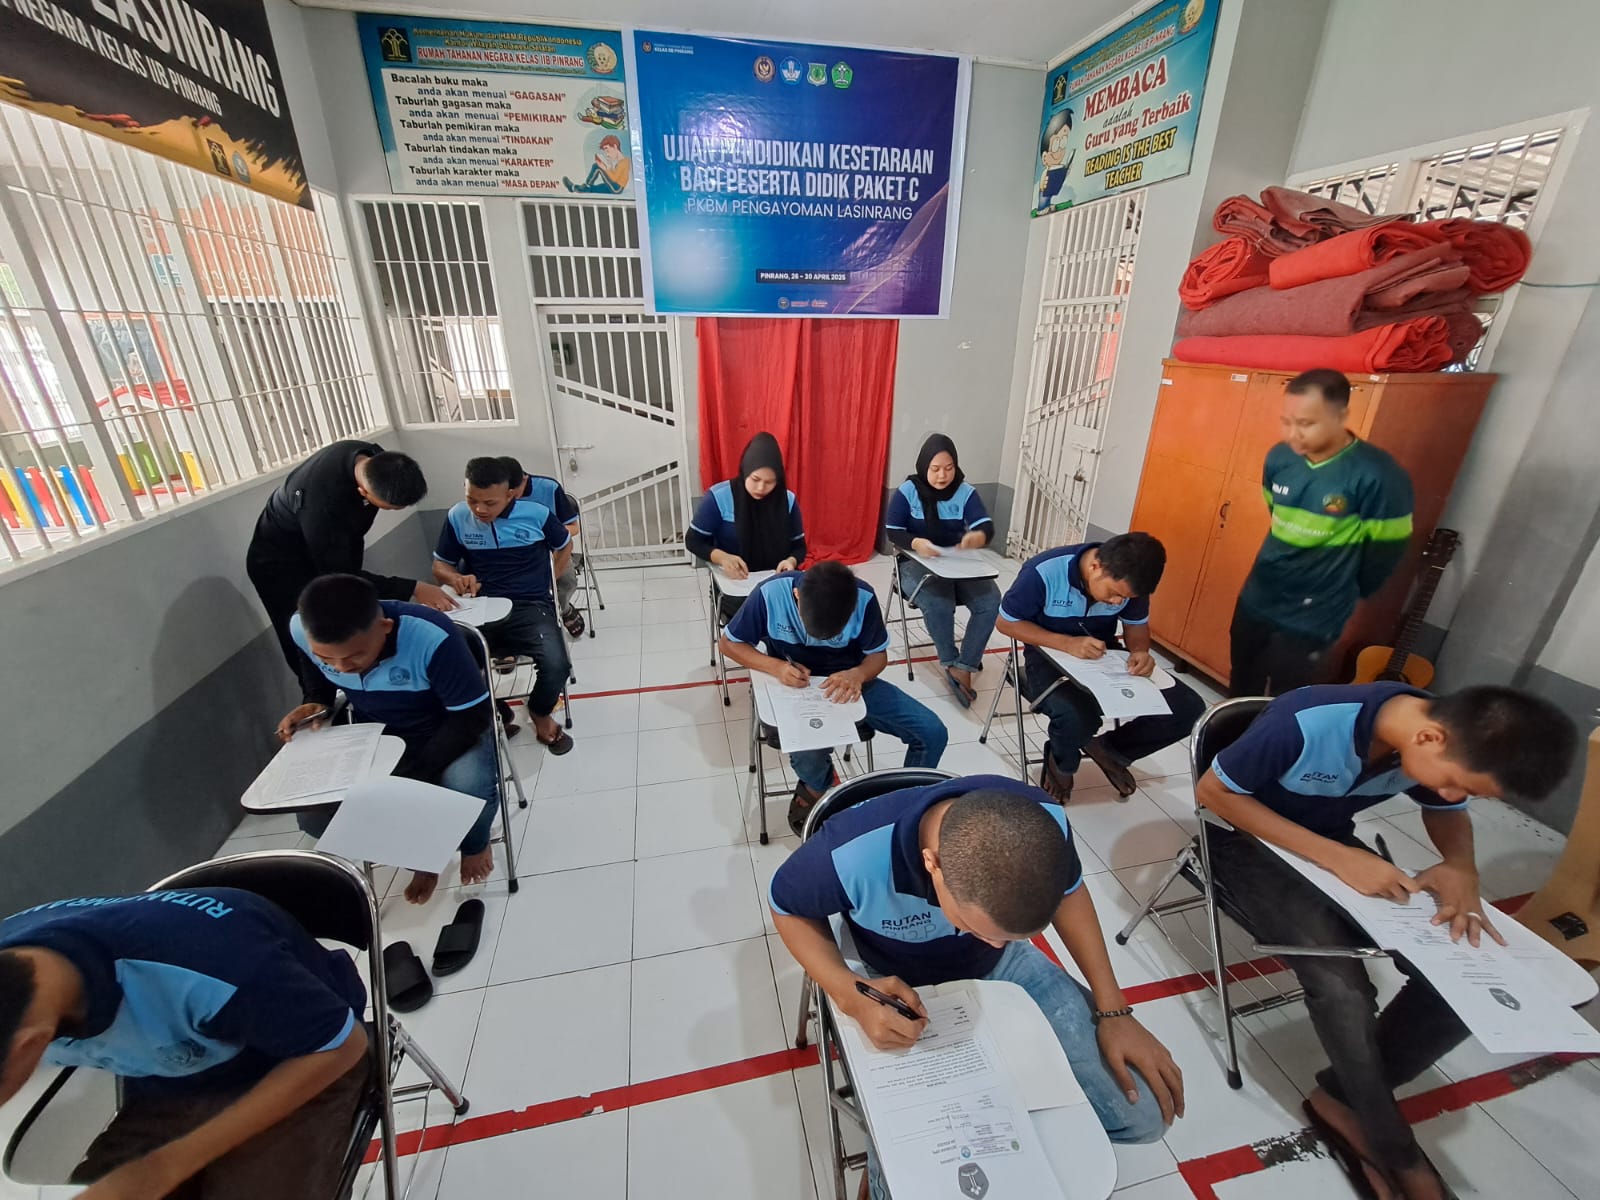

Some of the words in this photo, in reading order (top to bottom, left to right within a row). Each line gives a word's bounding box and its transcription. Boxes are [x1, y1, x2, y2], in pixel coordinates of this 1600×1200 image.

[15, 0, 94, 50] NEGARA
[90, 25, 148, 78] KELAS
[146, 56, 170, 89] IIB
[168, 68, 223, 116] PINRANG
[92, 0, 281, 118] ASINRANG
[417, 47, 445, 58] RUMAH
[447, 49, 482, 61] TAHANAN
[484, 51, 513, 62] NEGARA
[516, 53, 538, 64] KELAS
[541, 54, 550, 65] IIB
[553, 55, 584, 67] PINRANG
[391, 73, 432, 84] Bacalah
[434, 77, 459, 86] buku
[462, 79, 488, 87] maka
[418, 86, 441, 96] anda
[445, 88, 469, 97] akan
[472, 90, 507, 99] menuai
[1083, 57, 1167, 121] MEMBACA
[395, 96, 439, 106] Taburlah
[442, 99, 483, 110] gagasan
[486, 101, 511, 109] maka
[409, 109, 433, 118] anda
[436, 110, 460, 119] akan
[464, 112, 499, 120] menuai
[1085, 127, 1111, 151] Guru
[1111, 118, 1139, 144] yang
[1141, 92, 1191, 129] Terbaik
[1102, 101, 1135, 128] adalah
[400, 119, 442, 129] Taburlah
[445, 121, 492, 132] pemikiran
[495, 124, 520, 133] maka
[423, 132, 444, 141] anda
[446, 133, 466, 142] akan
[469, 134, 499, 143] menuai
[405, 143, 447, 153] Taburlah
[449, 145, 489, 154] tindakan
[492, 147, 517, 155] maka
[663, 134, 718, 162] UJIAN
[721, 138, 825, 169] PENDIDIKAN
[829, 143, 934, 175] KESETARAAN
[1084, 147, 1121, 177] READING
[1120, 143, 1132, 164] IS
[1132, 136, 1152, 160] THE
[1151, 126, 1178, 154] BEST
[423, 156, 444, 164] anda
[446, 157, 466, 165] akan
[469, 158, 499, 166] menuai
[409, 166, 450, 175] Taburlah
[453, 168, 492, 176] karakter
[495, 169, 519, 177] maka
[1105, 161, 1143, 190] TEACHER
[416, 178, 438, 186] anda
[441, 179, 464, 187] akan
[466, 180, 499, 188] menuai
[680, 166, 724, 193] BAGI
[726, 169, 801, 197] PESERTA
[805, 173, 850, 199] DIDIK
[854, 175, 906, 202] PAKET
[908, 177, 919, 202] C
[687, 197, 728, 214] PKBM
[732, 200, 833, 218] PENGAYOMAN
[837, 203, 913, 221] LASINRANG
[760, 272, 791, 281] PINRANG,
[813, 273, 830, 281] APRIL
[831, 273, 846, 281] 2025
[881, 911, 931, 927] RUTAN
